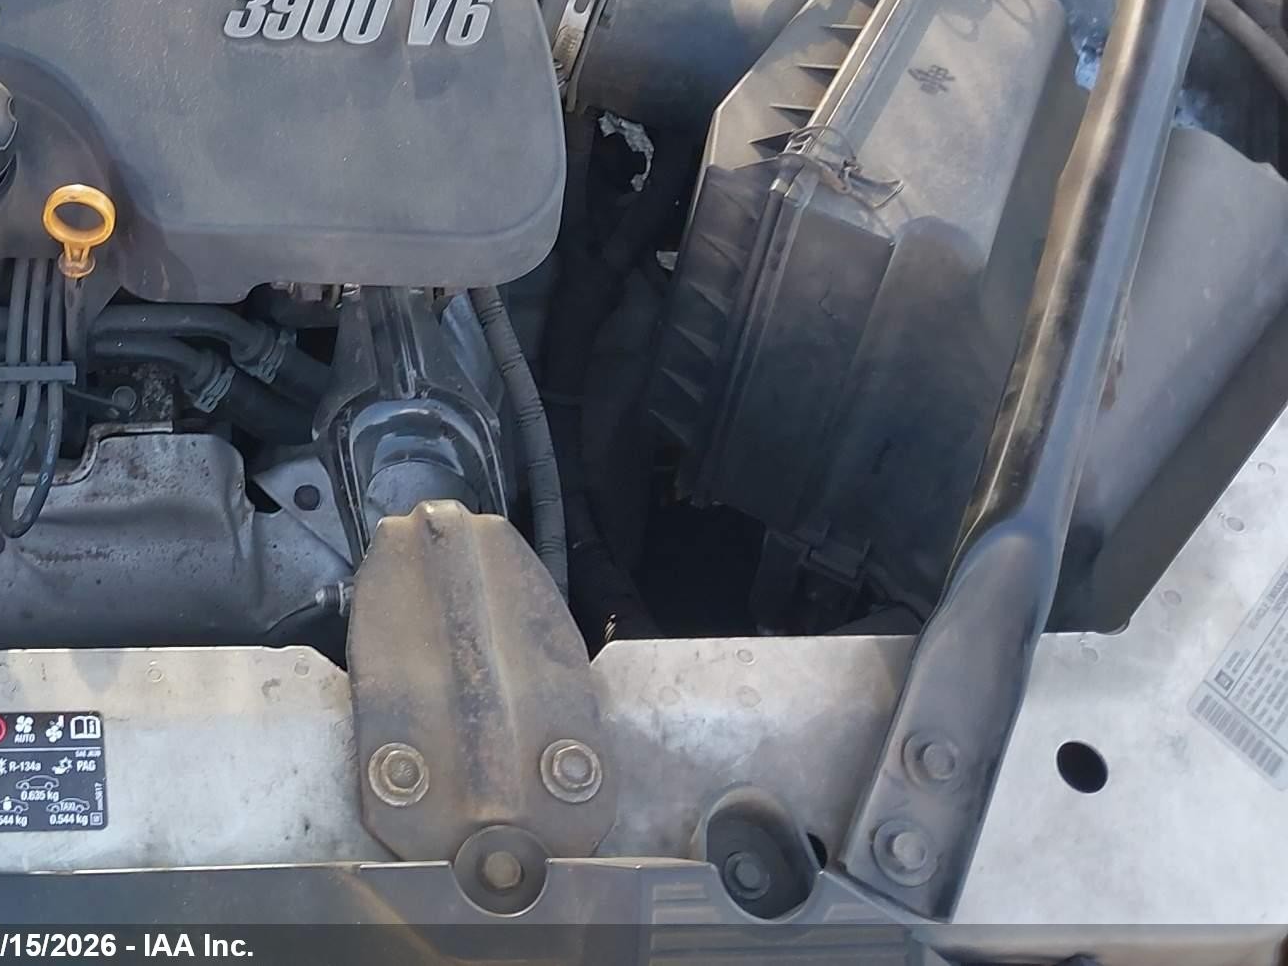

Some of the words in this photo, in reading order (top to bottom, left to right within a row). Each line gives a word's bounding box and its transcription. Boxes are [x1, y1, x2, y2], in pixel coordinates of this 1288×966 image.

[14, 734, 35, 743] AUTO
[8, 762, 42, 772] R-134a
[76, 761, 96, 772] PAG
[47, 791, 59, 802] kg
[15, 815, 28, 827] kg
[49, 814, 75, 825] 0.544
[76, 814, 88, 826] kg
